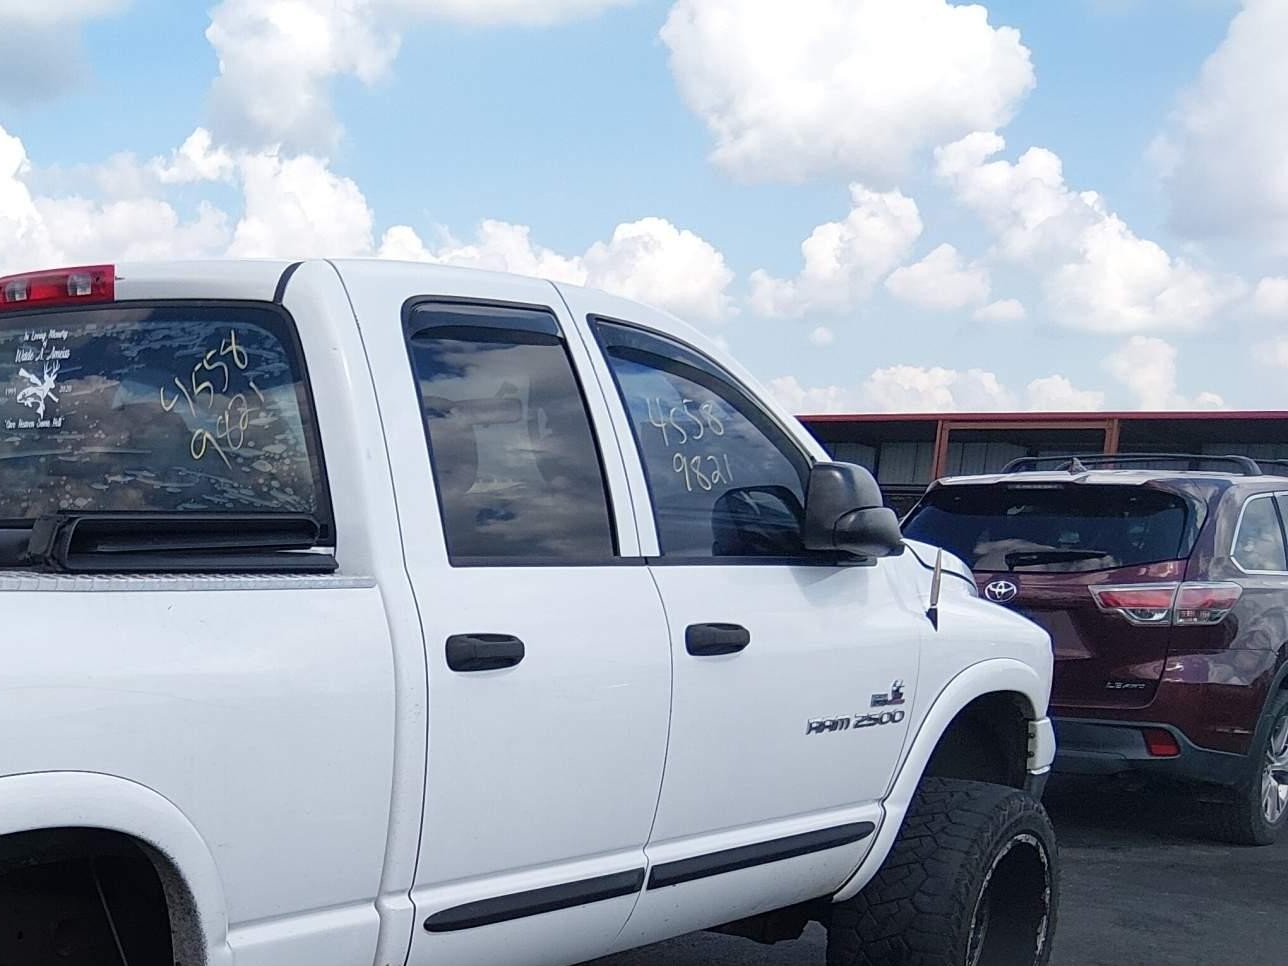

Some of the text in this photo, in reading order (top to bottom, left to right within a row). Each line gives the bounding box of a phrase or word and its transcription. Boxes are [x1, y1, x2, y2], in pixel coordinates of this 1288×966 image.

[645, 396, 725, 447] 4558
[672, 451, 734, 493] 9821
[806, 710, 905, 735] RAM 2500
